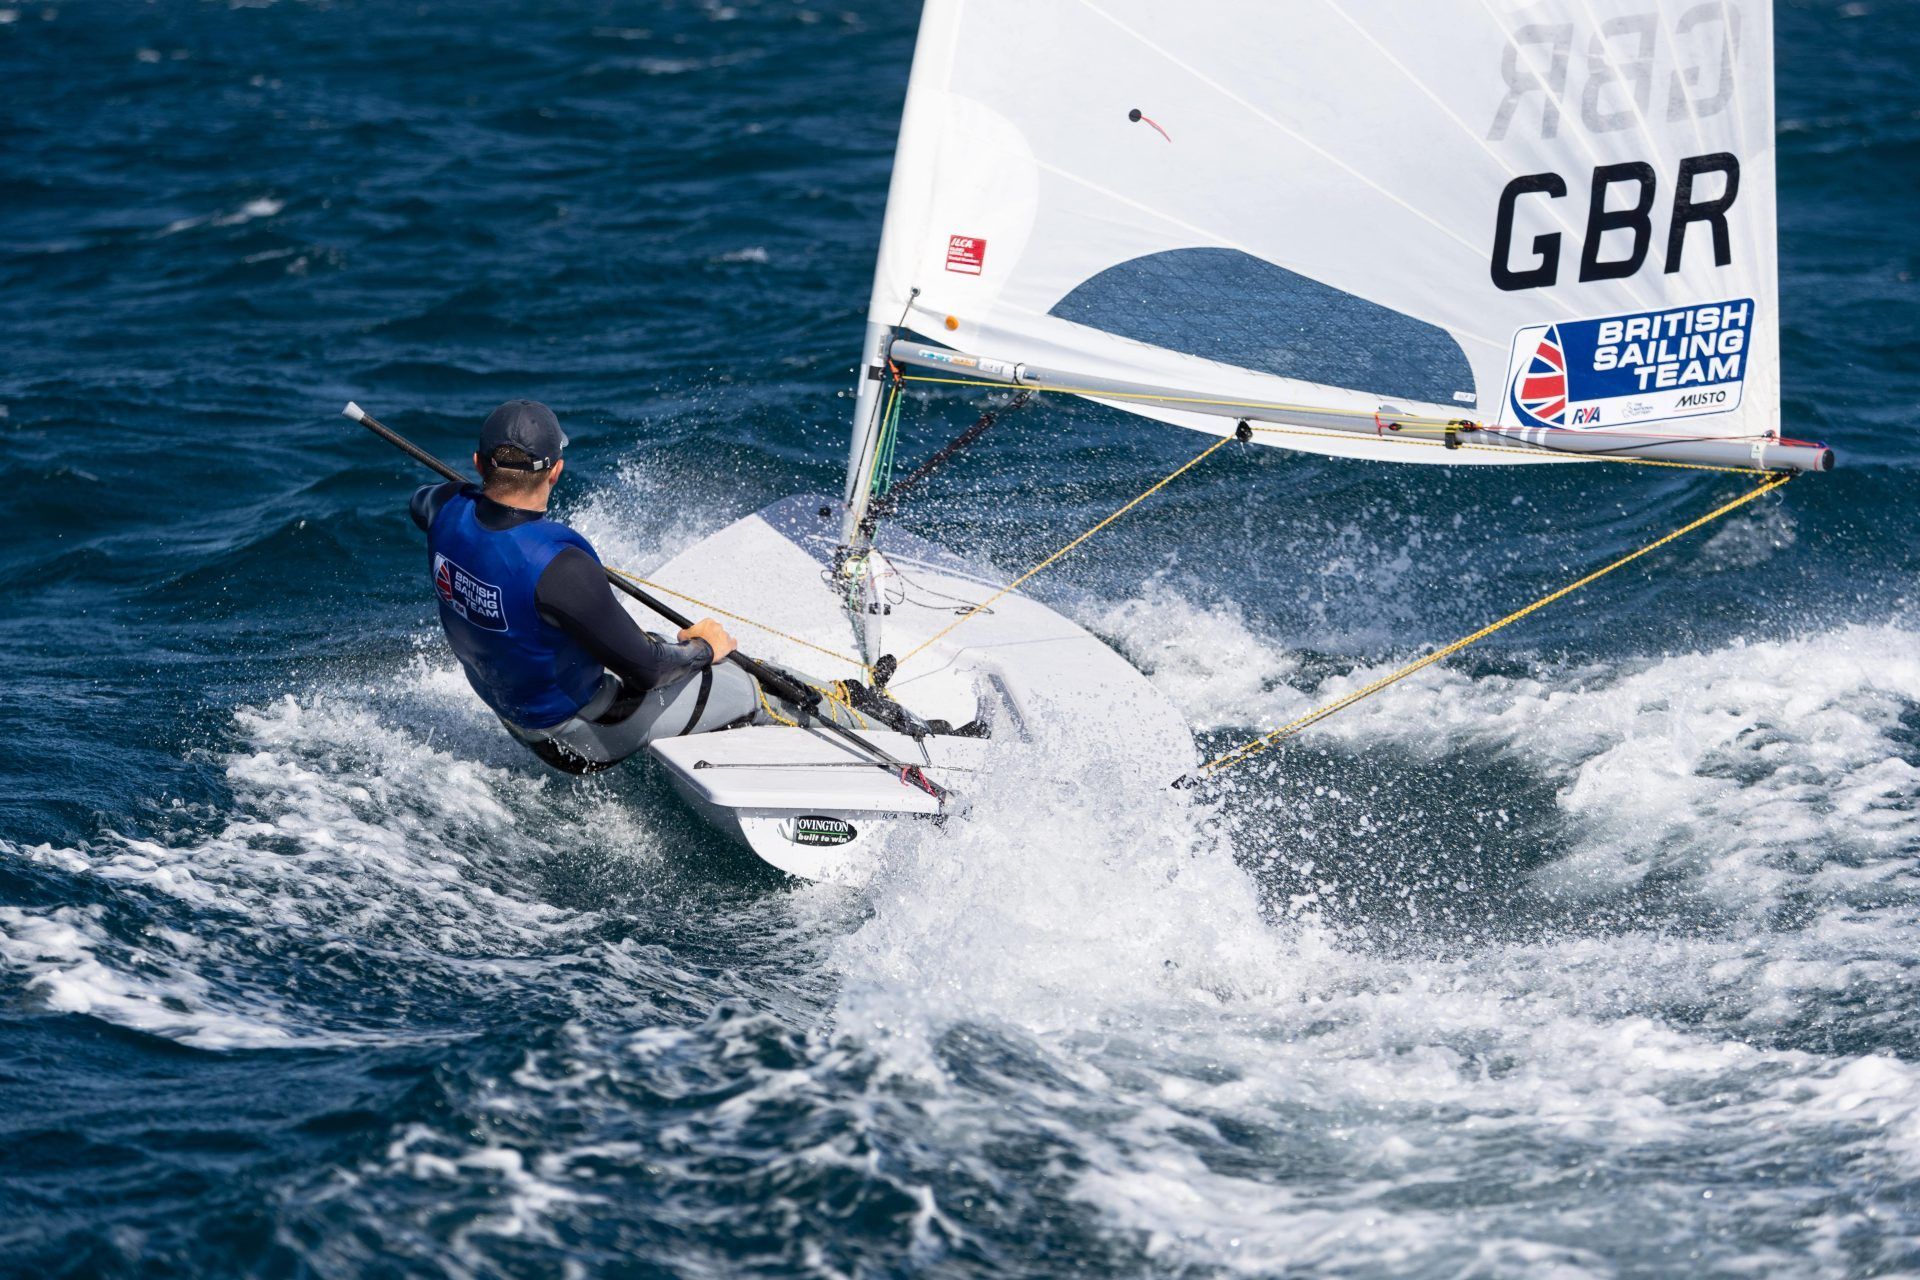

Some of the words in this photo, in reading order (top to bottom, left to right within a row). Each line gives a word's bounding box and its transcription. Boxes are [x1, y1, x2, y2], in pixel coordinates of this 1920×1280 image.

[1490, 151, 1740, 292] GBR
[1597, 302, 1748, 347] BRITISH
[1592, 328, 1745, 372] SAILING
[1633, 353, 1741, 391] TEAM
[1674, 390, 1727, 409] MUSTO
[1571, 405, 1600, 426] RYA
[454, 581, 498, 610] SAILING
[455, 571, 497, 600] BRITISH
[464, 598, 499, 618] TEAM
[798, 833, 818, 842] built
[820, 835, 830, 843] to
[799, 818, 849, 833] OVINGTON
